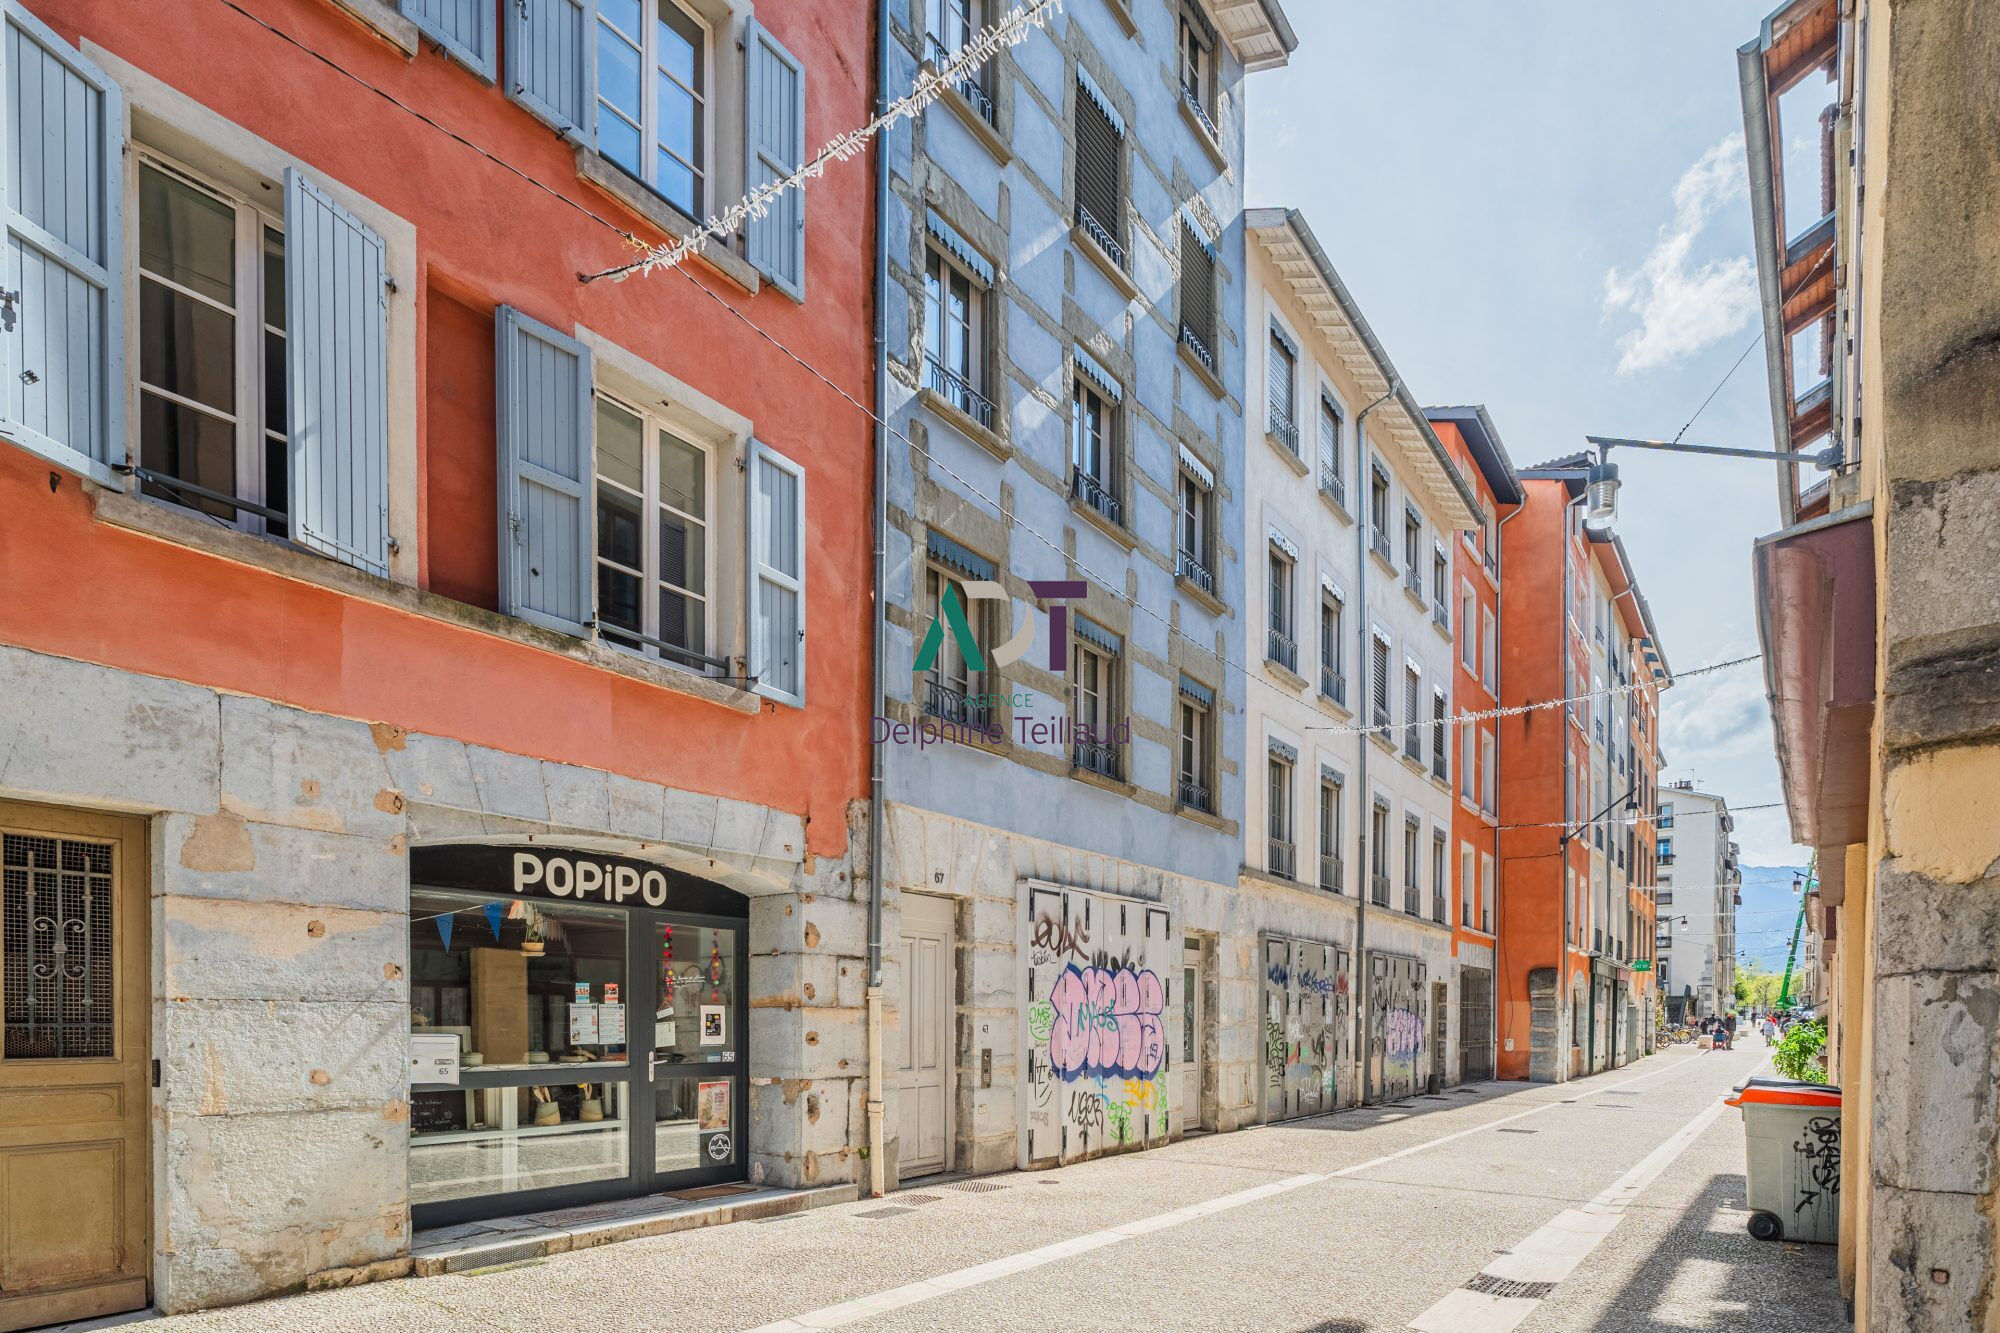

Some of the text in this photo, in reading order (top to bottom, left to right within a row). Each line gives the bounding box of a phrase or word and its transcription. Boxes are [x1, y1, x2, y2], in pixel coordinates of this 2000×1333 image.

[514, 852, 667, 906] POPiPO
[934, 872, 945, 884] 67
[439, 1067, 449, 1075] 65
